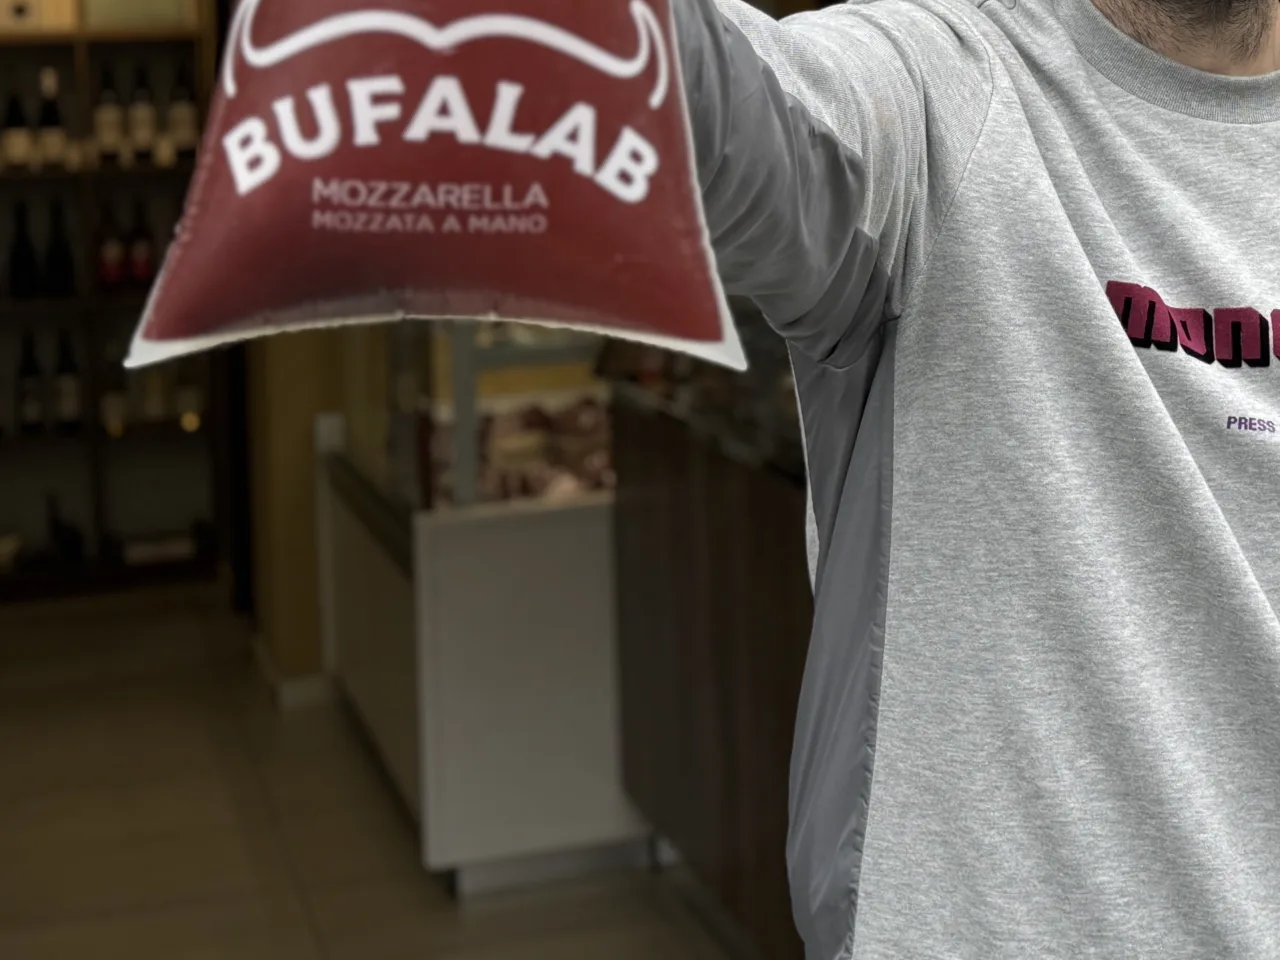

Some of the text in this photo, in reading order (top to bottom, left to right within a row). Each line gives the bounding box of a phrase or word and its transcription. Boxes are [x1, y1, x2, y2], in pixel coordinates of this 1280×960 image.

[222, 75, 659, 204] BUFALAB
[311, 176, 550, 210] MOZZARELLA
[311, 209, 548, 235] MOZZATA A MANO
[1226, 416, 1276, 435] PRESS
